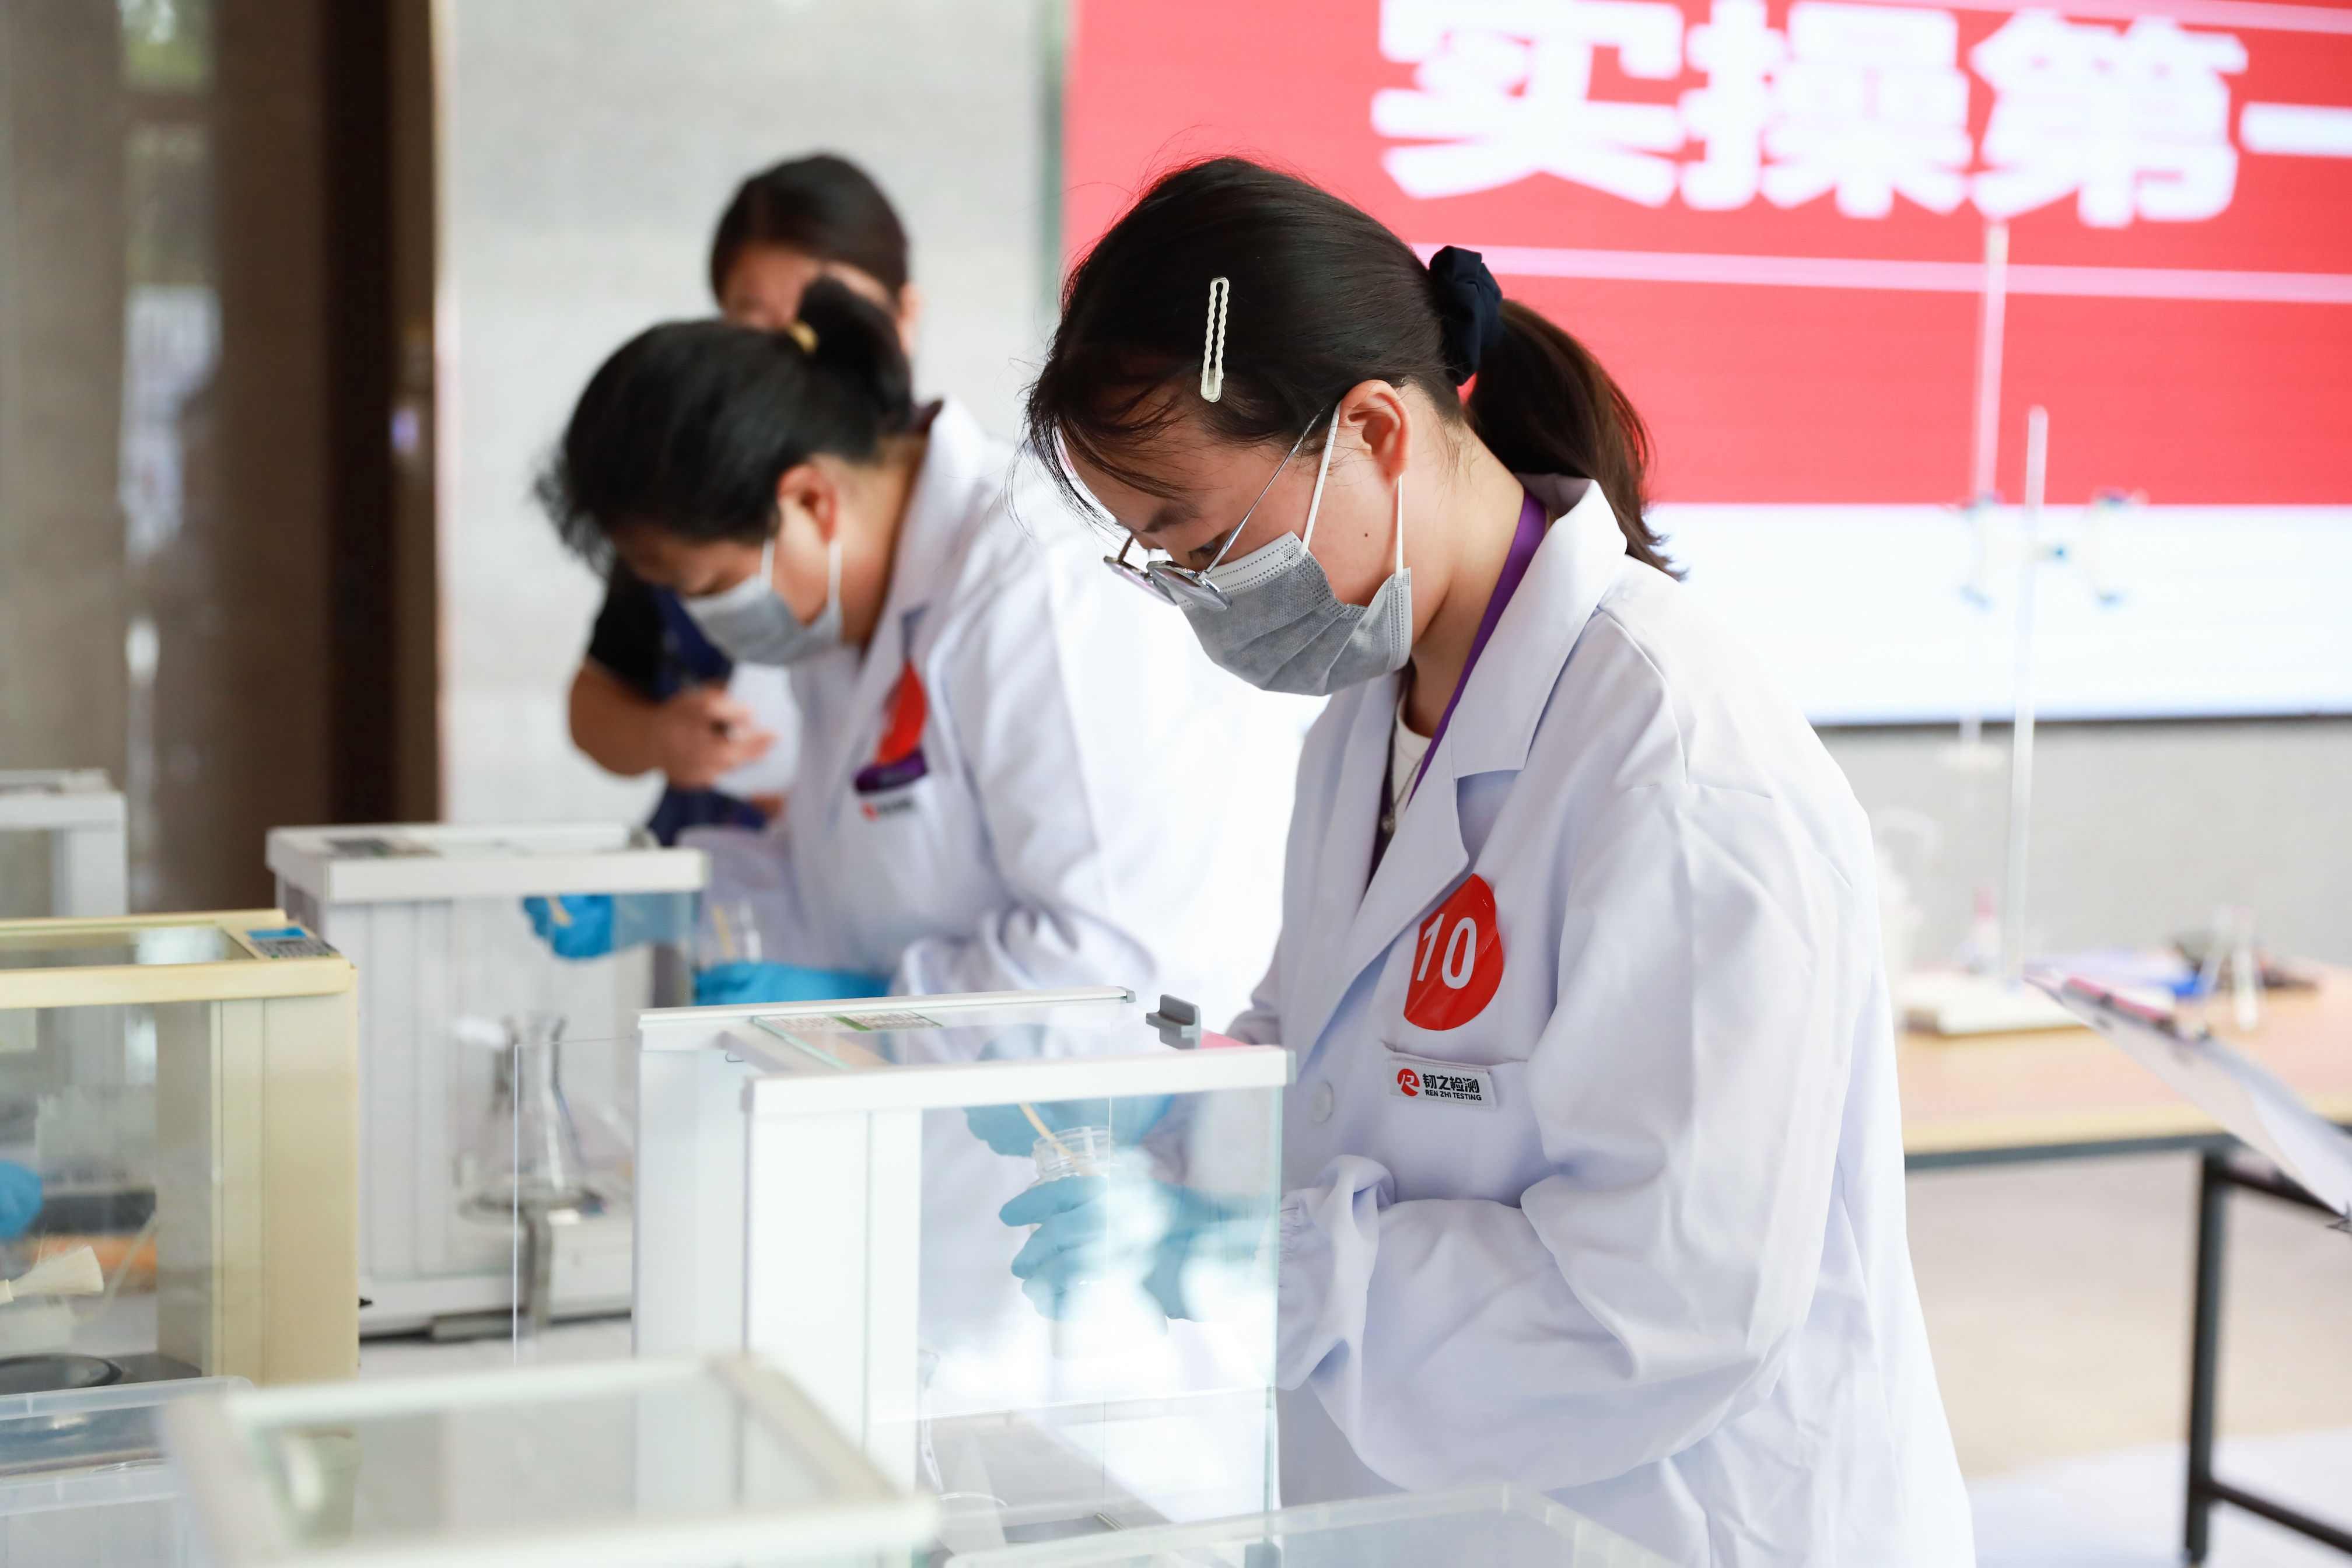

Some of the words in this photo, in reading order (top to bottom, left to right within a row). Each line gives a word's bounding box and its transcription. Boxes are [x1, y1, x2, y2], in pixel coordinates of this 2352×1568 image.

[1416, 913, 1477, 989] 10
[1422, 1073, 1480, 1093] 韧之检测
[1452, 1092, 1482, 1101] TESTING
